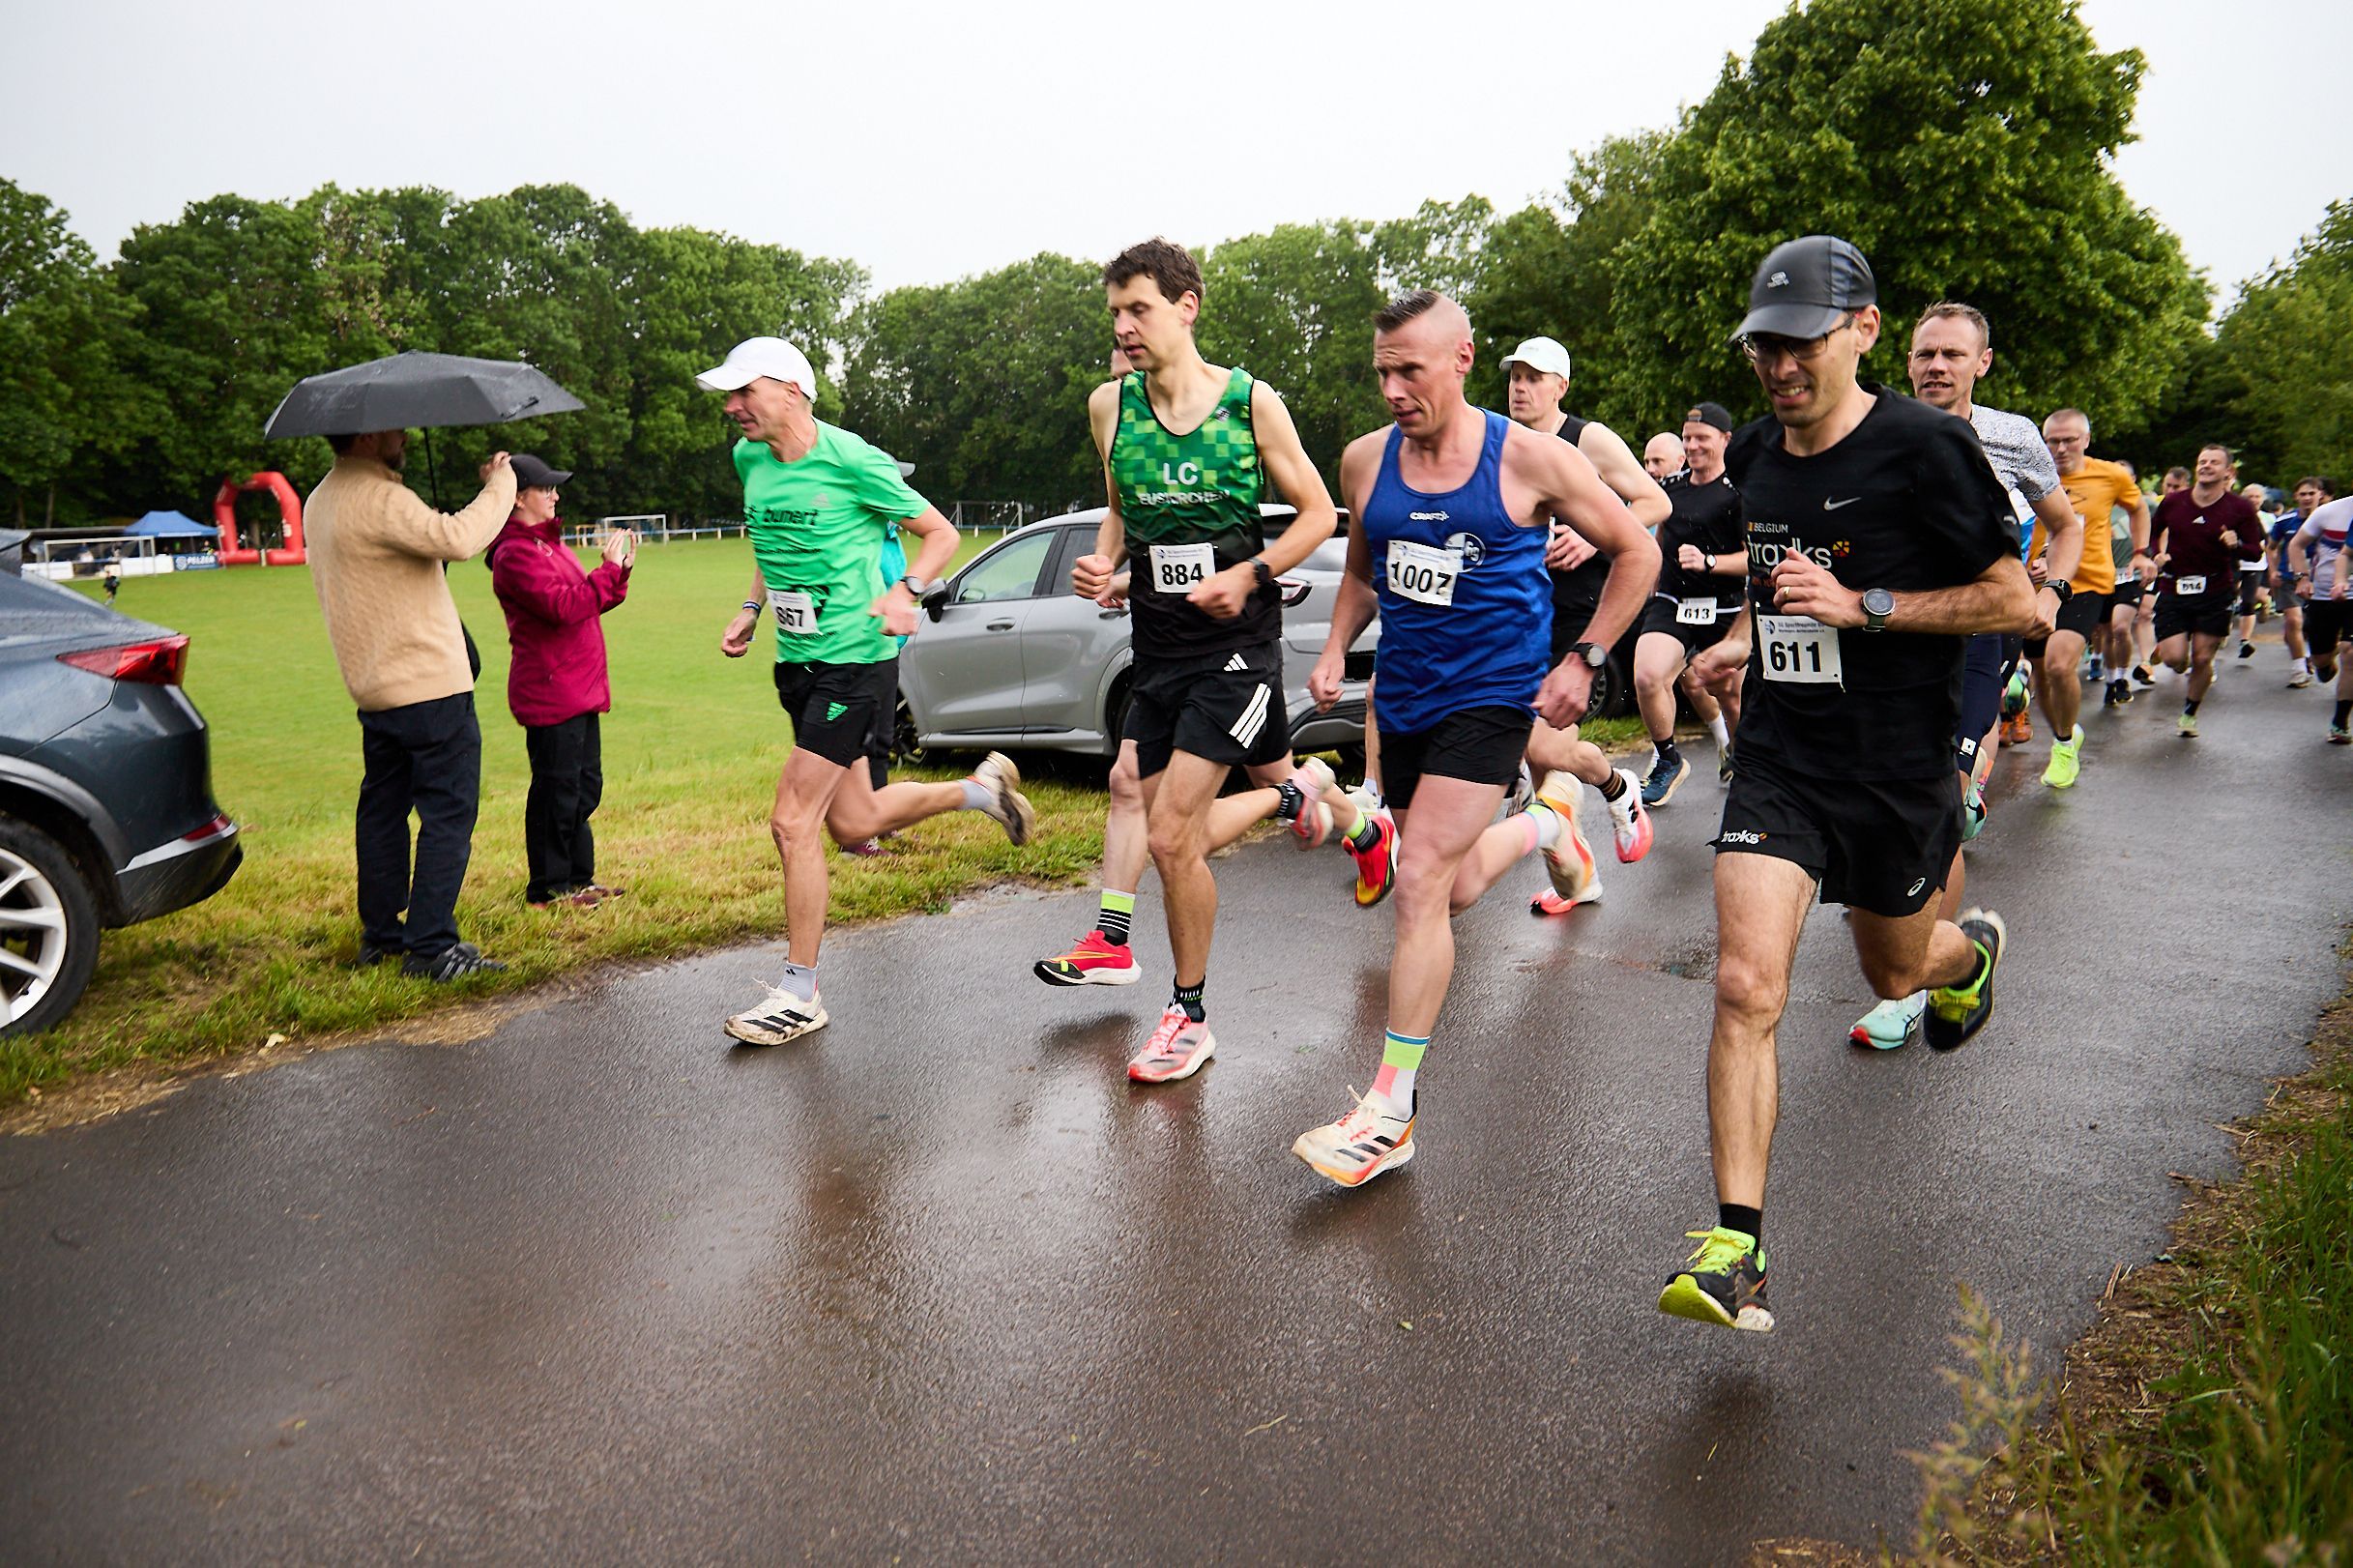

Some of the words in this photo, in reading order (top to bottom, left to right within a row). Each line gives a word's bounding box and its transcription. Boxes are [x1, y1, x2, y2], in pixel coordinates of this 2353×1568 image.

[1163, 462, 1198, 485] LC
[1754, 522, 1788, 534] BELGIUM
[1162, 563, 1205, 586] 884
[1391, 561, 1452, 595] 1007
[1684, 607, 1710, 619] 613
[1770, 641, 1821, 672] 611
